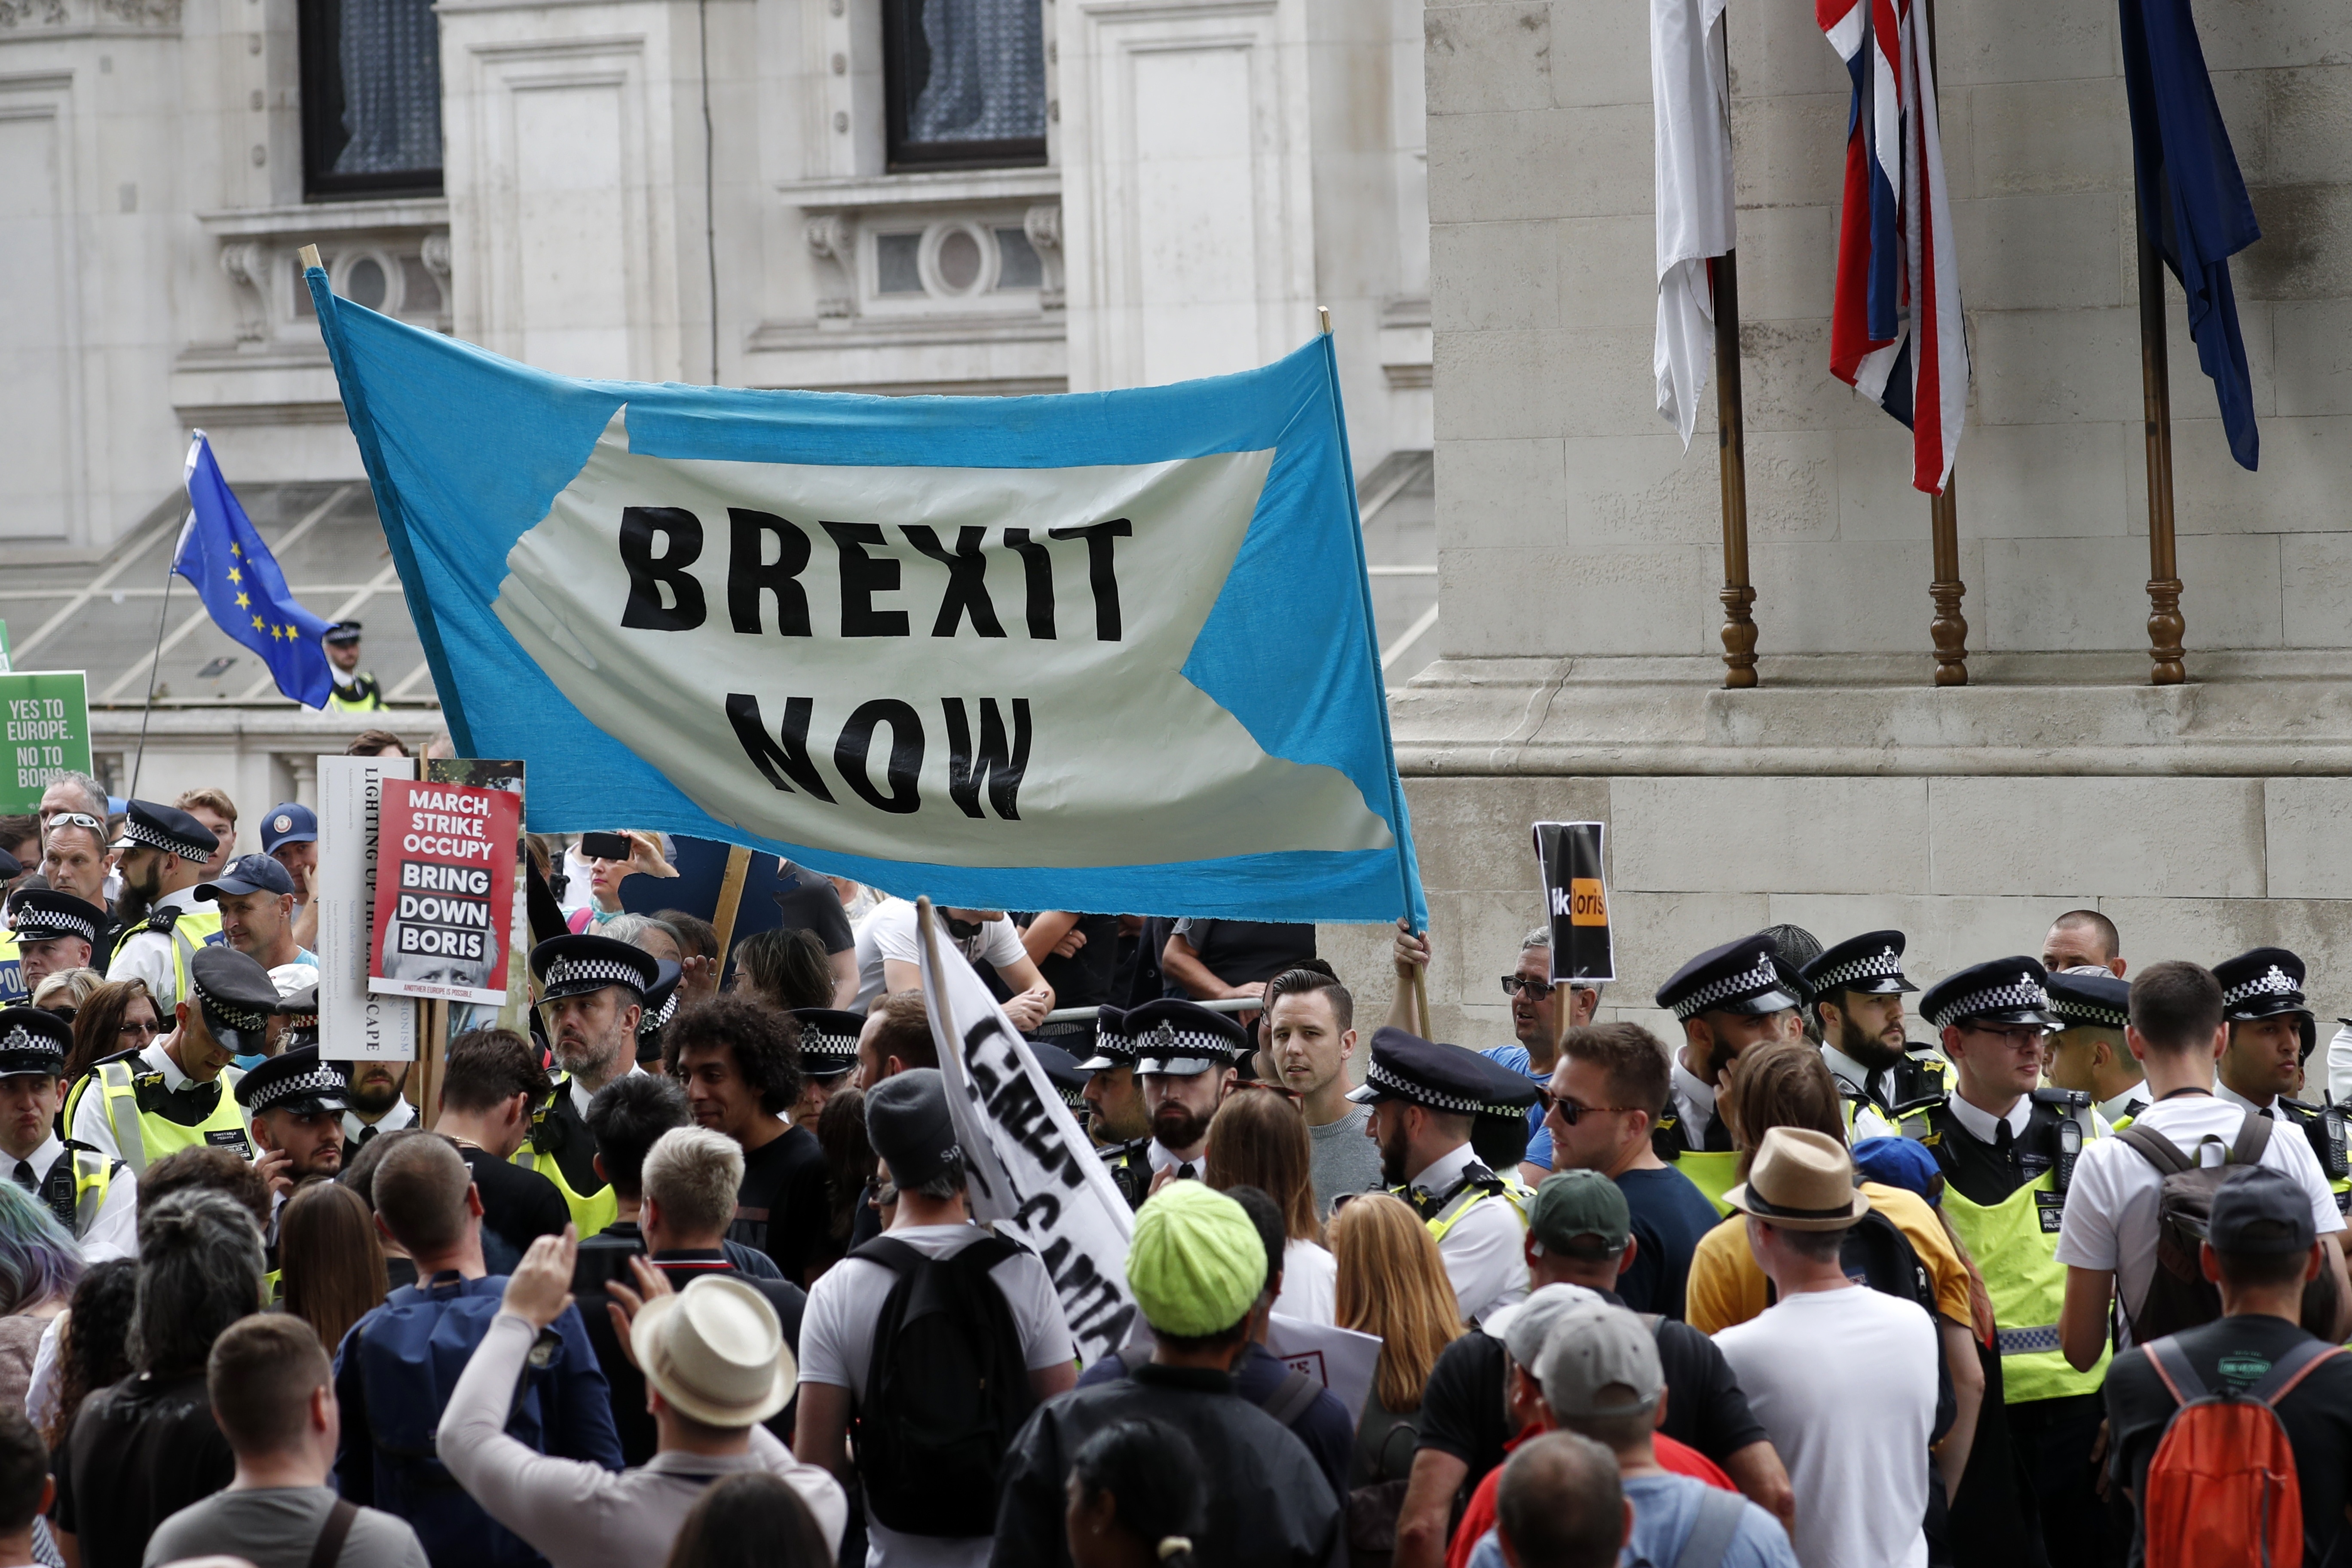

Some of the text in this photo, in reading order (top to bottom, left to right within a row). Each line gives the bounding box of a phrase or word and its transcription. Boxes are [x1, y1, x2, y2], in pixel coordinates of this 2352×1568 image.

[619, 506, 1133, 642] BREXIT
[9, 698, 64, 720] YES TO
[6, 720, 74, 741] EUROPE.
[16, 746, 62, 766] NO TO
[725, 693, 1032, 821] NOW
[365, 768, 379, 860] LIGHTING
[409, 790, 492, 818] MARCH,
[412, 812, 486, 839] STRIKE,
[403, 835, 493, 860] OCCUPY
[365, 867, 377, 891] UP
[403, 864, 489, 894] BRING
[399, 895, 488, 927] DOWN
[401, 927, 481, 958] BORIS
[0, 967, 28, 993] POL
[404, 984, 426, 992] ANOTHER
[451, 989, 472, 998] POSSIBLE
[1014, 1194, 1137, 1356] CAPITA
